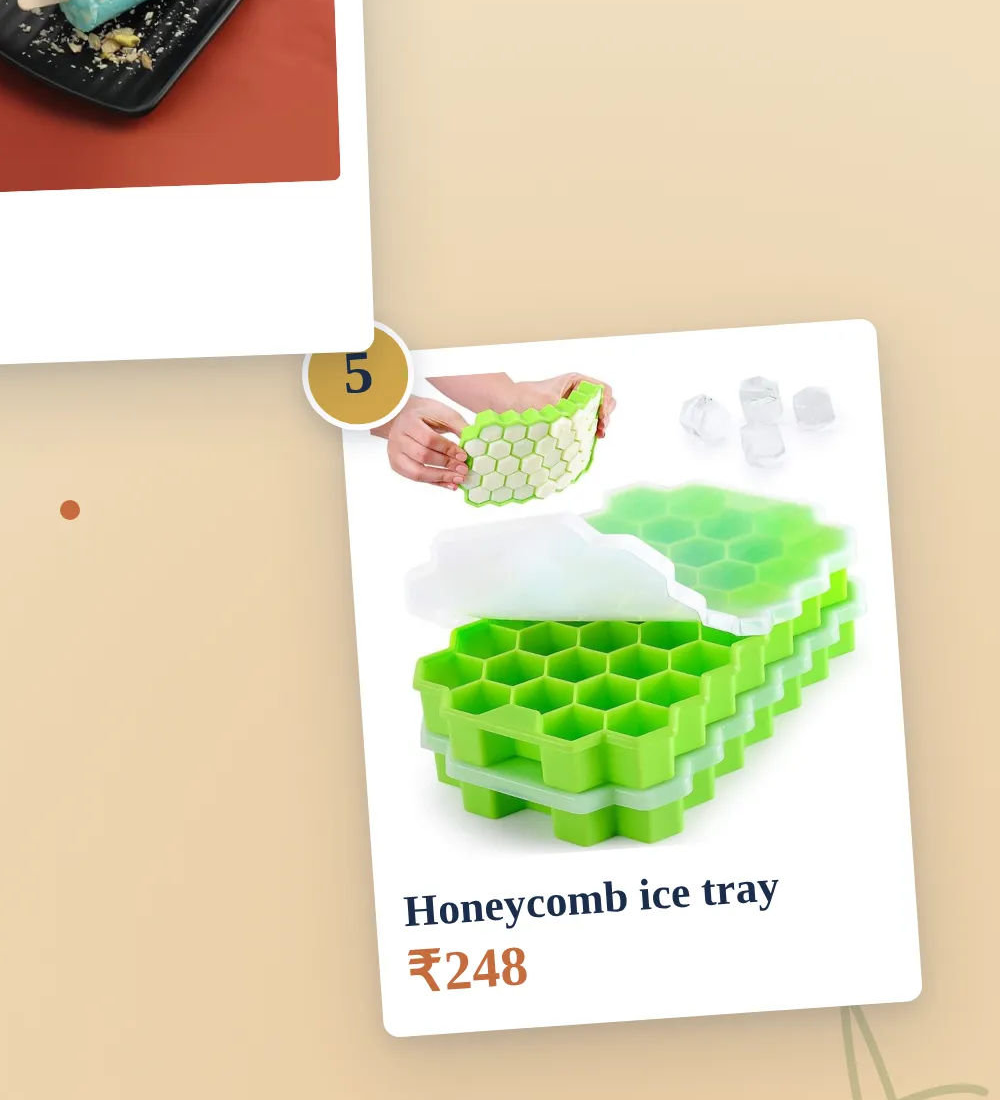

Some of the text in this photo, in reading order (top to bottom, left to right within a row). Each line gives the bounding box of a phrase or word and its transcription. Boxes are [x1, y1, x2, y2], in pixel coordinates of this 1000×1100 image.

[345, 352, 372, 394] 5
[403, 876, 779, 930] Honeycomb ice tray
[407, 946, 528, 992] ₹248
